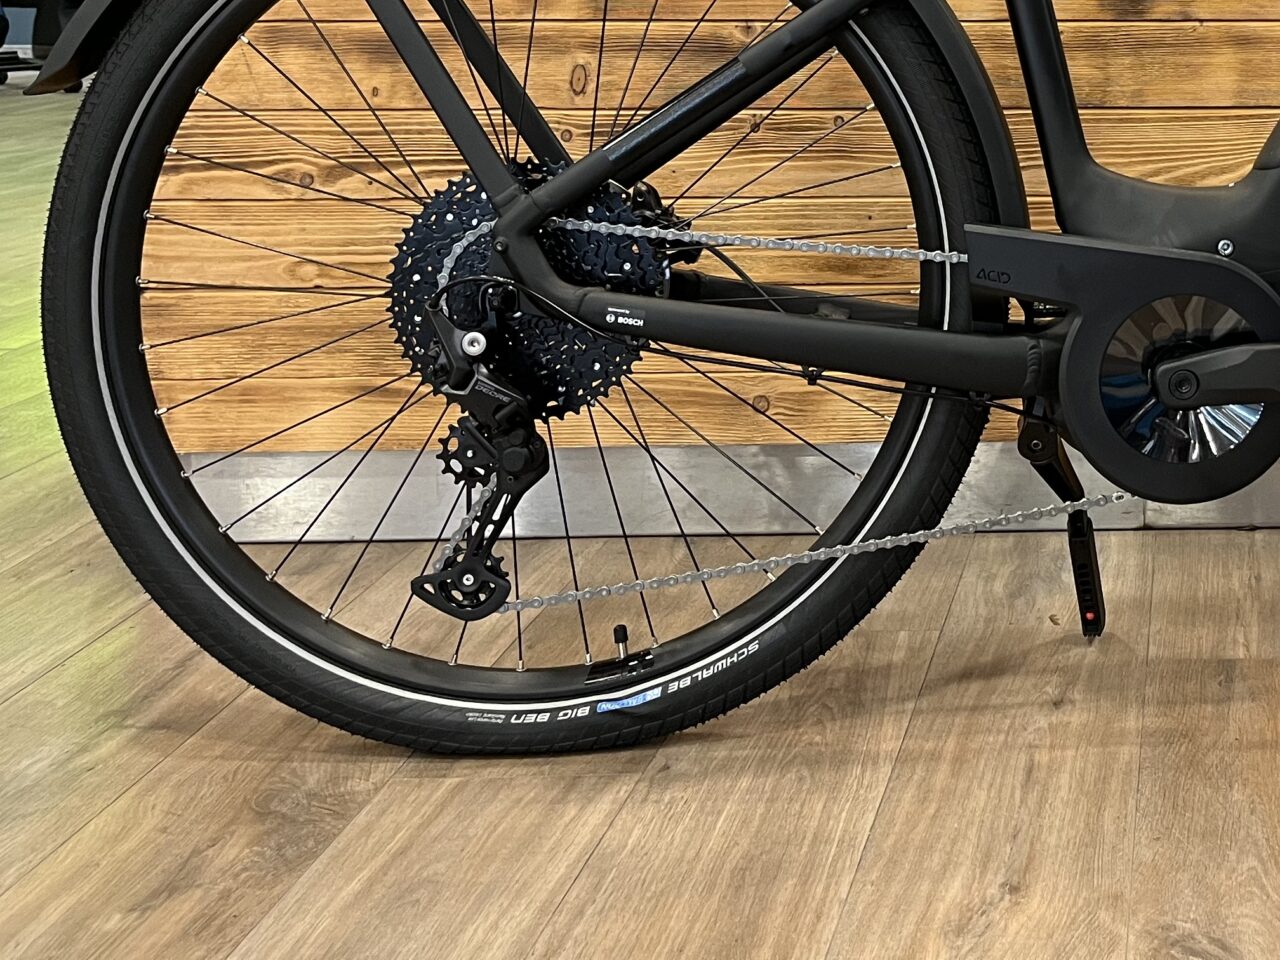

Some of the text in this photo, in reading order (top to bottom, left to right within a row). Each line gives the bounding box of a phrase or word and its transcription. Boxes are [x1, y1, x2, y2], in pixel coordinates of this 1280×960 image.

[617, 316, 644, 327] BOSCH
[474, 383, 512, 403] DEORE
[667, 640, 760, 694] SCHWALBE
[510, 711, 550, 724] BEN
[556, 705, 590, 721] BIG
